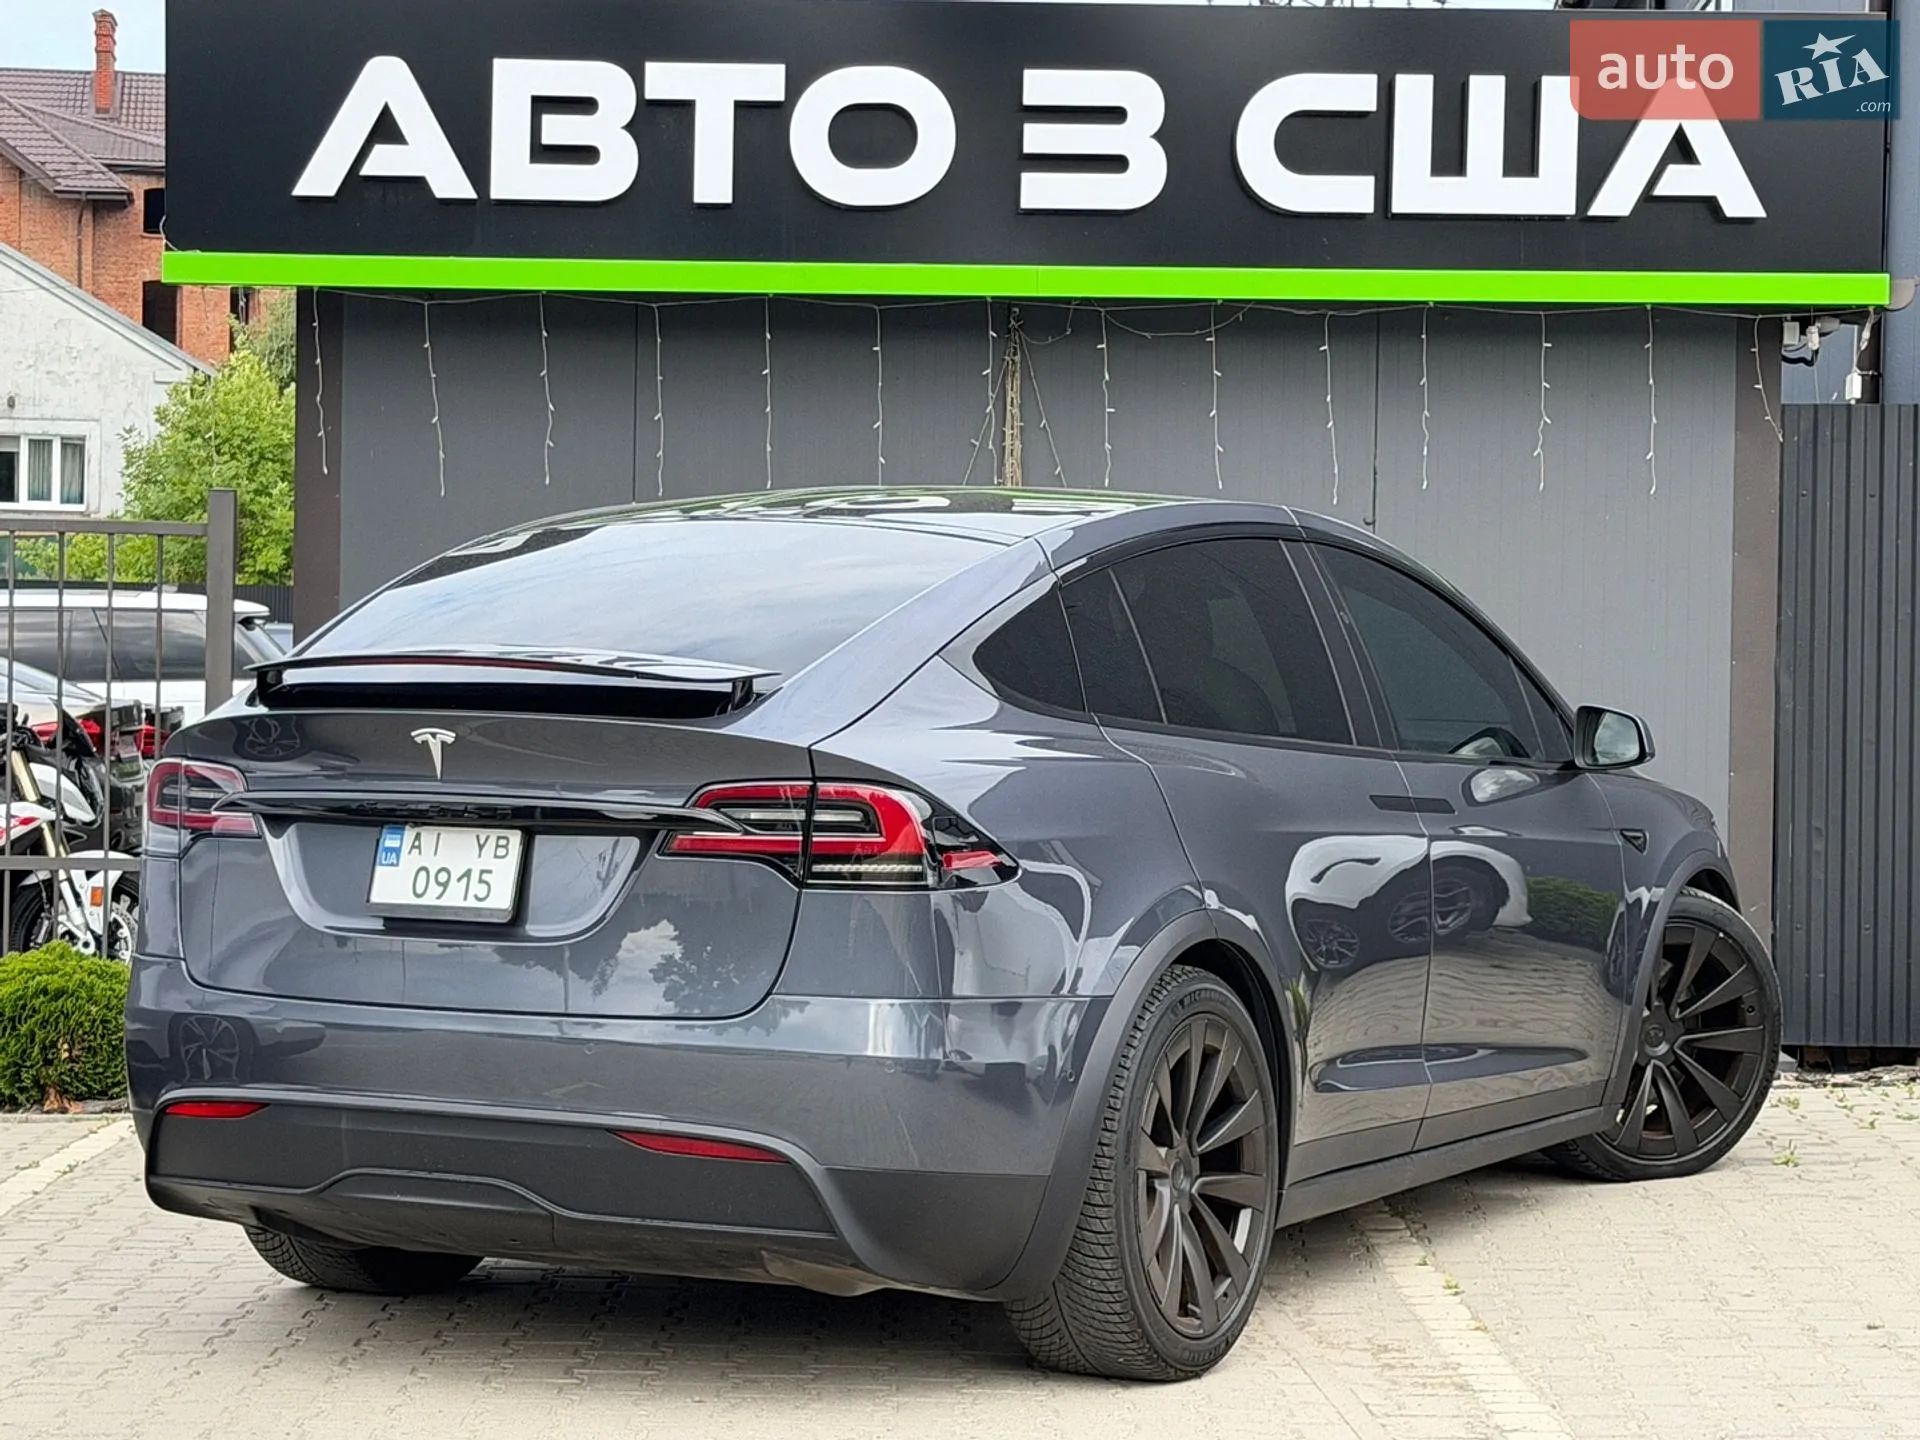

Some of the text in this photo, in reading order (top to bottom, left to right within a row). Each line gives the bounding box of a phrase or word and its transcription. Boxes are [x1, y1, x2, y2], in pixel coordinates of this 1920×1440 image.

[291, 55, 1767, 217] АВТО З США
[381, 851, 398, 865] UA
[408, 832, 511, 859] AI YB
[412, 865, 494, 902] 0915
